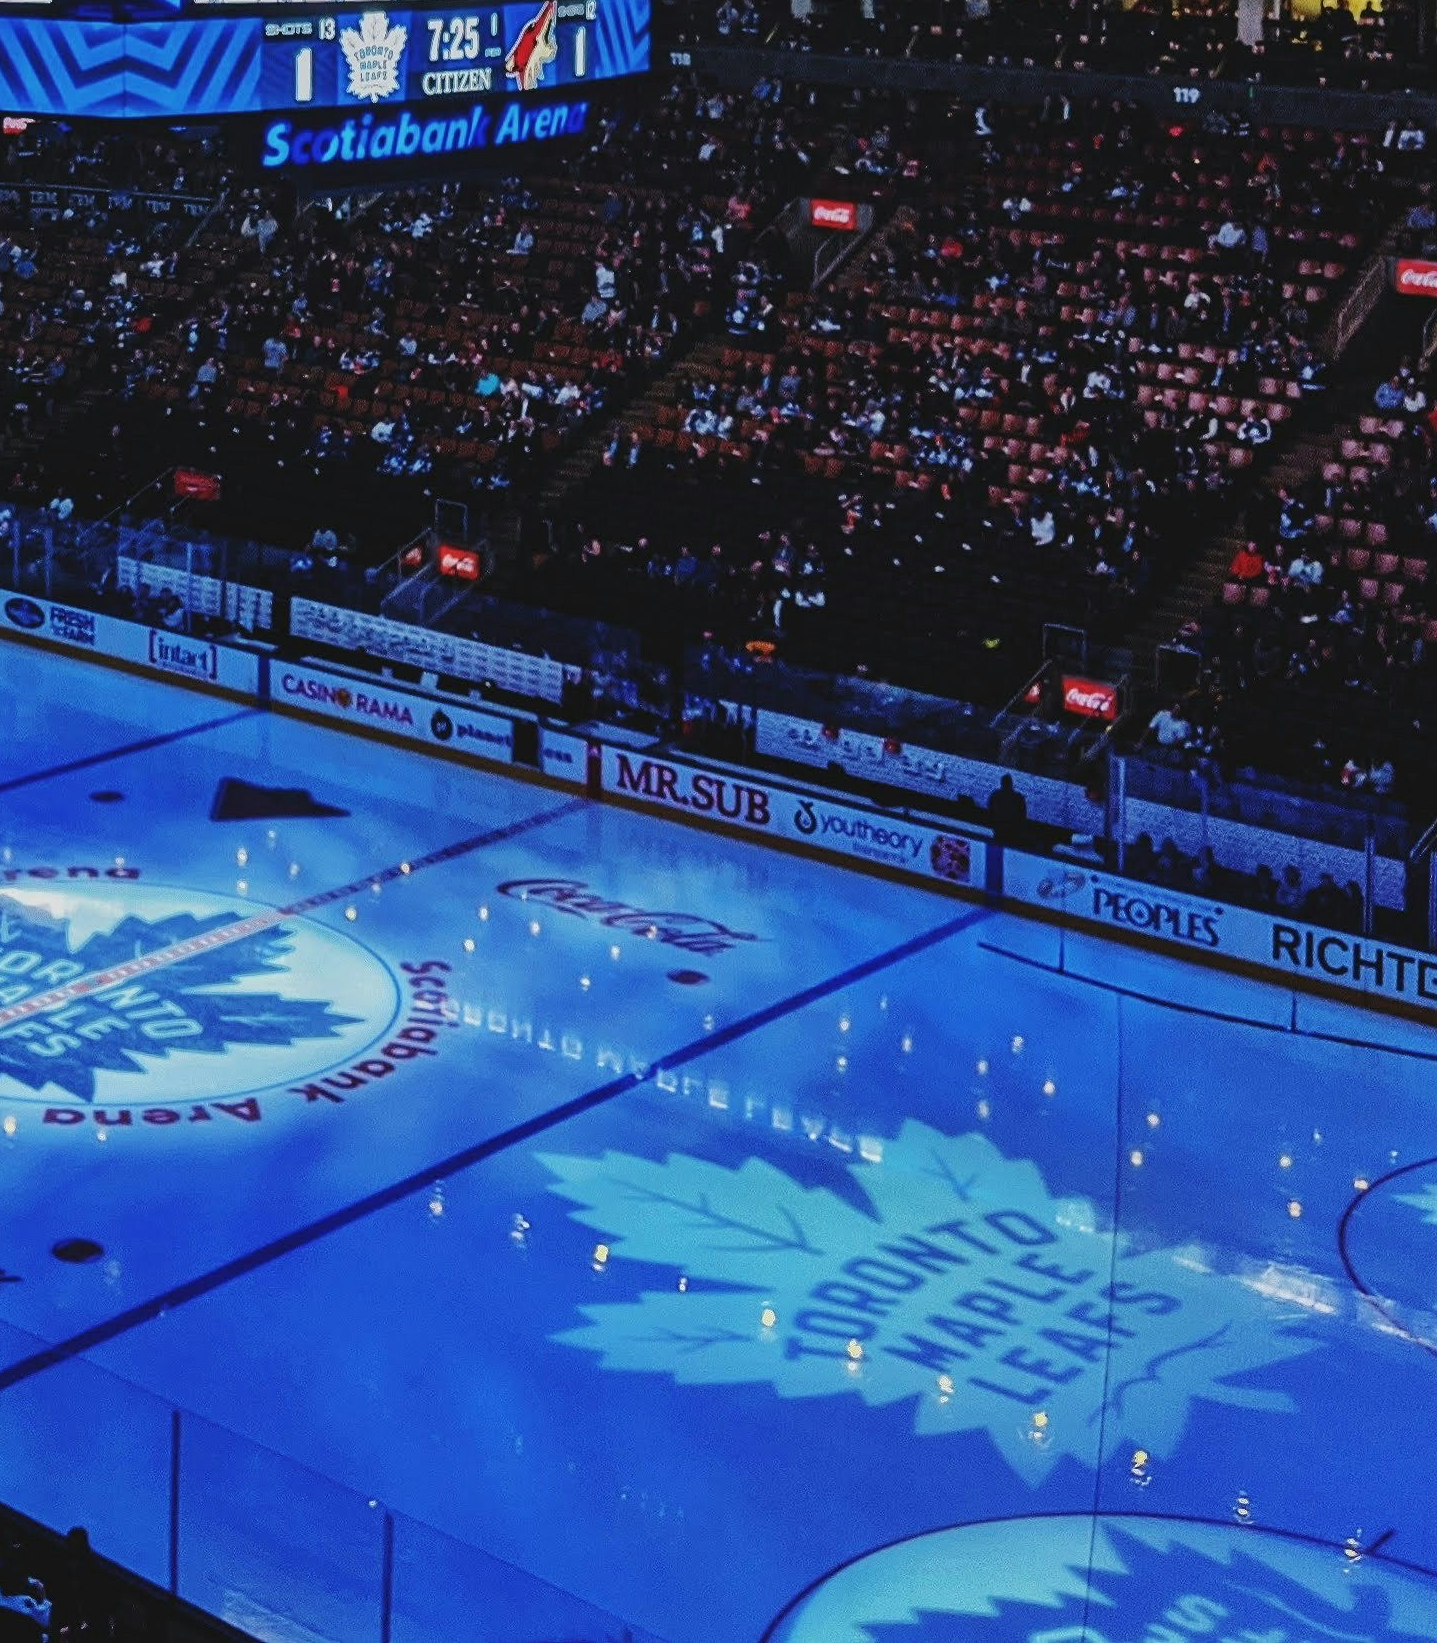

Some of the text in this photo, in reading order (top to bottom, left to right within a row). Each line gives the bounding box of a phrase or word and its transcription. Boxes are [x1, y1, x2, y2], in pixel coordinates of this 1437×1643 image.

[265, 17, 336, 40] SHOTS 13
[585, 0, 596, 21] 12
[427, 16, 479, 62] 7:25
[574, 25, 586, 77] 1
[295, 47, 313, 101] 1
[422, 67, 492, 96] CITIZEN
[1173, 87, 1201, 104] 119
[262, 100, 590, 168] Scotiabank Arena
[356, 692, 414, 725] RAMA
[821, 812, 925, 858] youtheory
[496, 877, 760, 957] Coca-Cola
[1093, 888, 1220, 947] PEOPLES
[1272, 923, 1437, 1001] RICHTE
[43, 1098, 262, 1125] Arena
[784, 1210, 1058, 1362] TORONTO
[880, 1253, 1095, 1374] MAPLE
[967, 1281, 1182, 1406] LEAFS
